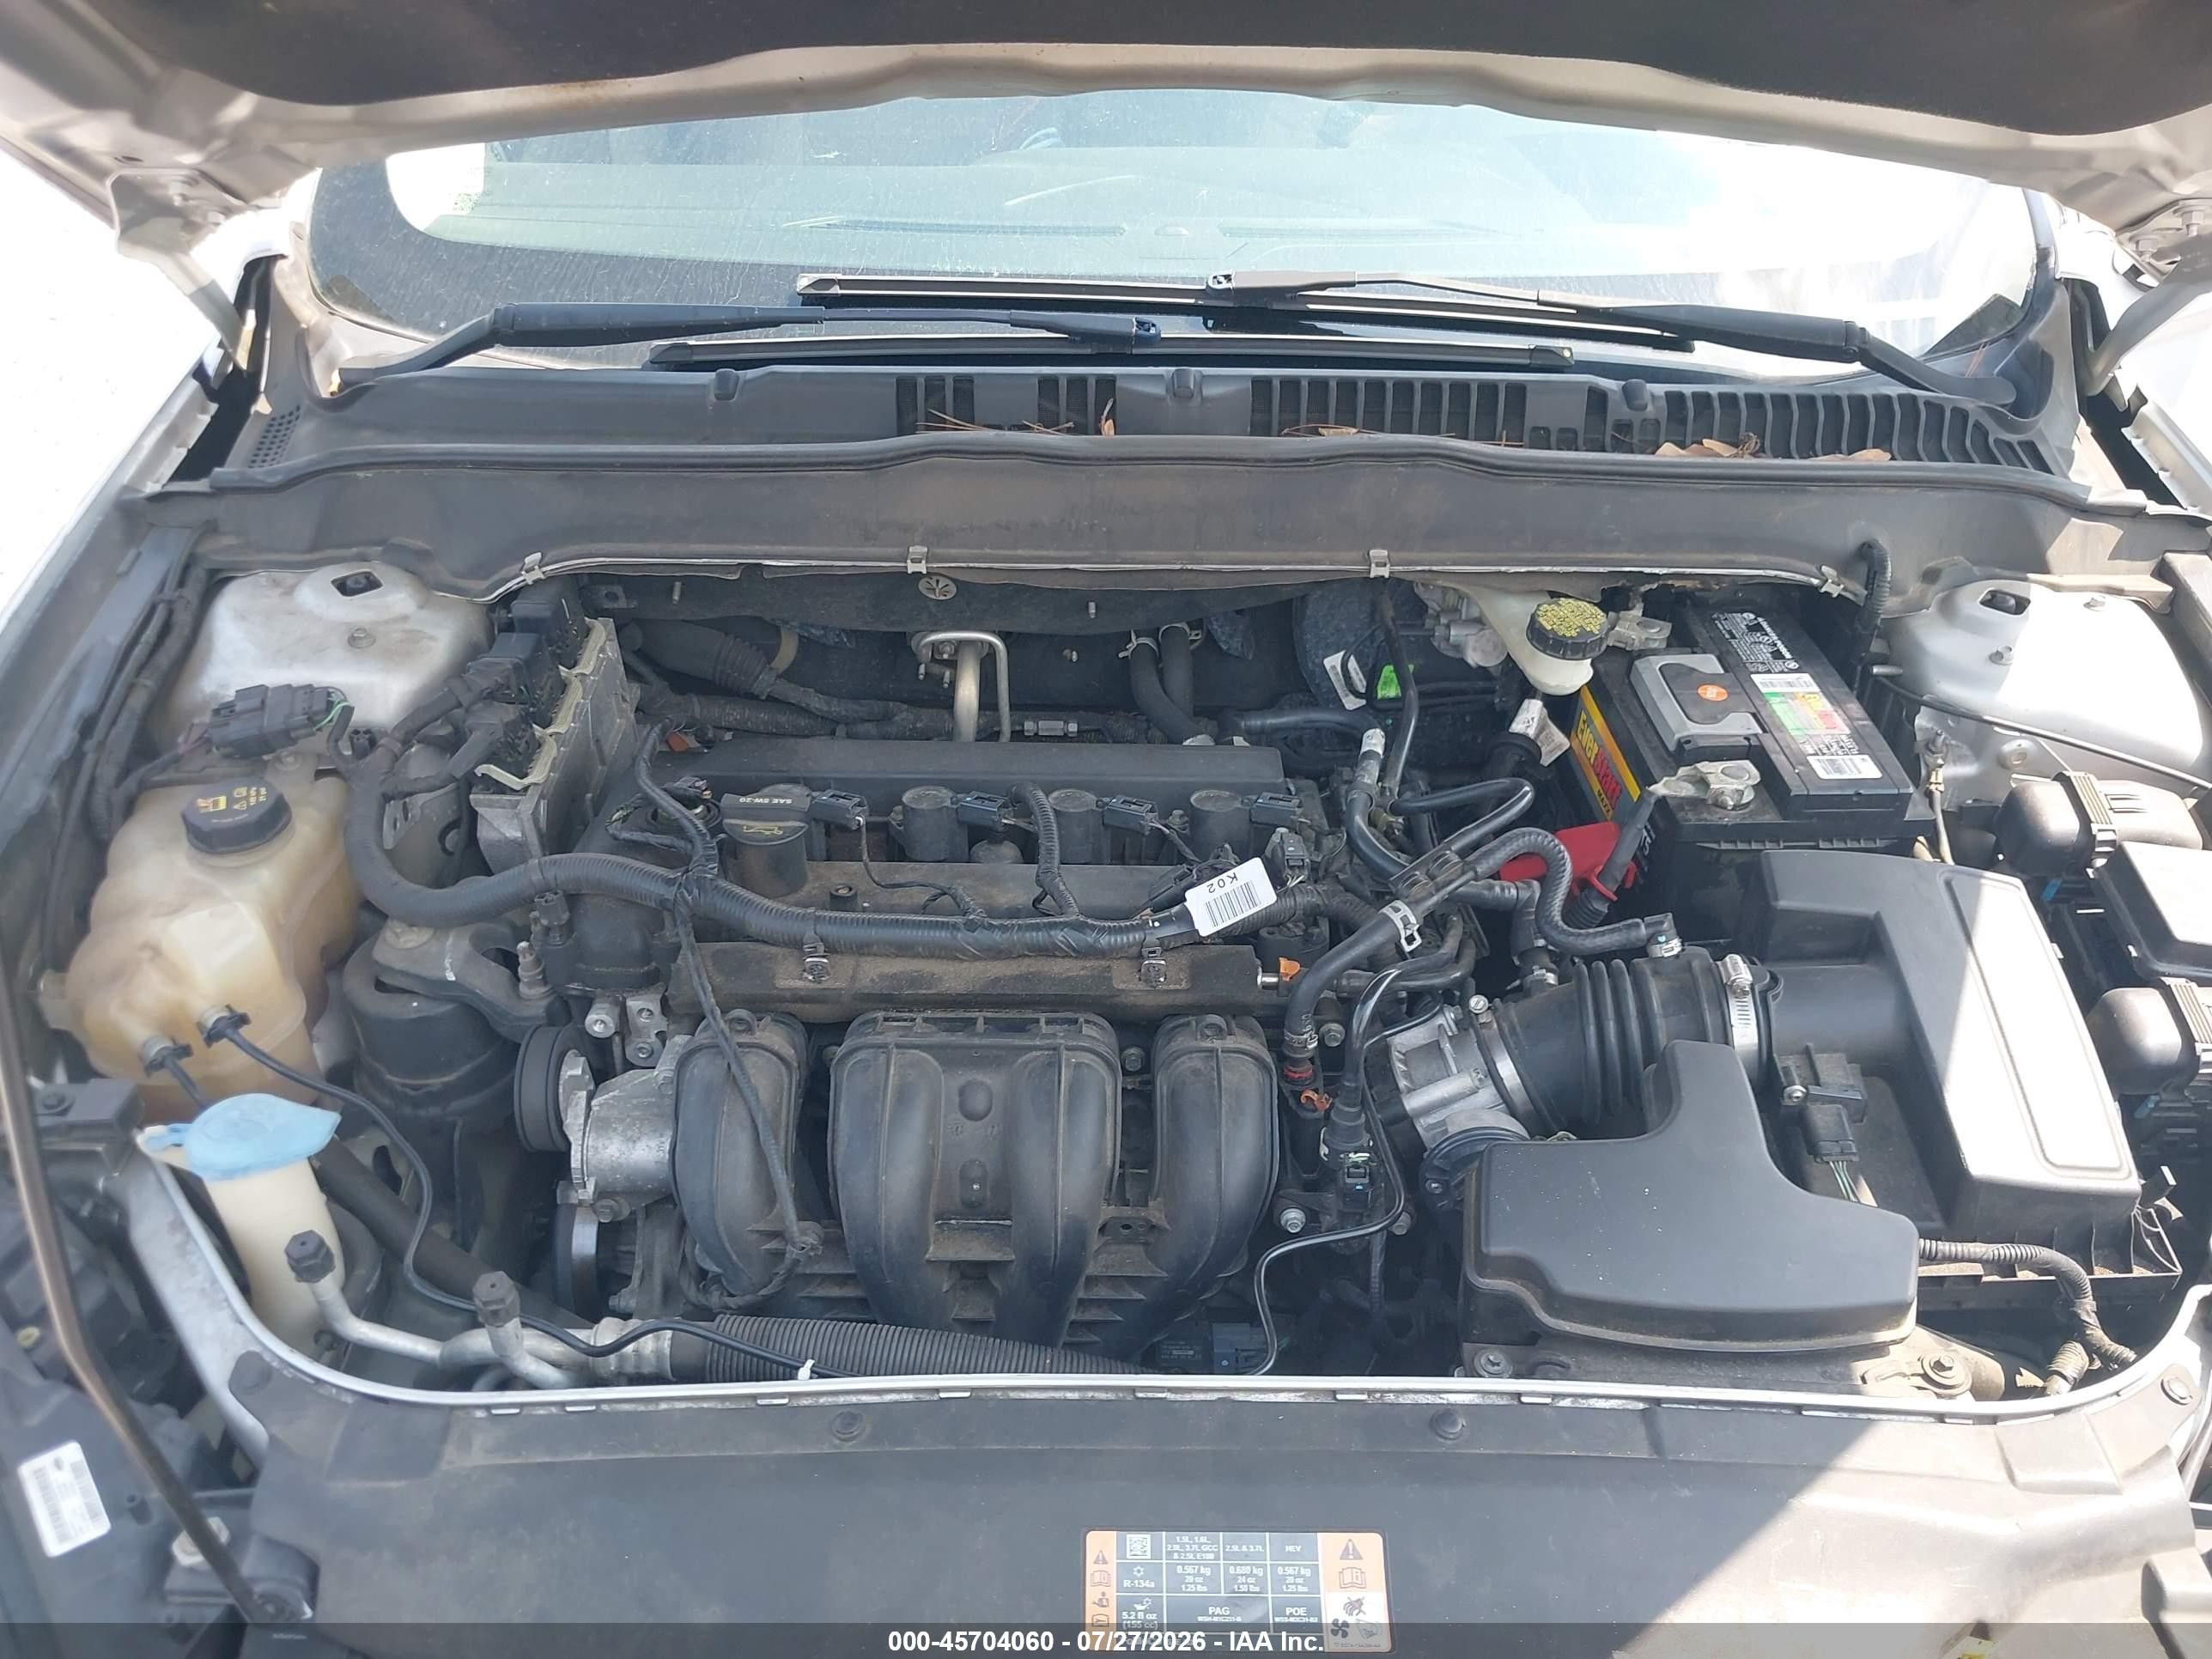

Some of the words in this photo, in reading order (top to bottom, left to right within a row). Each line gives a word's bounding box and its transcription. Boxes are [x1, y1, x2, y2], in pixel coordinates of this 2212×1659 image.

[1176, 1565, 1199, 1574] 0.567
[1200, 1565, 1211, 1577] kg
[1252, 1565, 1264, 1577] kg
[1277, 1566, 1298, 1575] 0.567
[1300, 1566, 1311, 1577] kg
[1123, 1579, 1155, 1588] R-134a
[1121, 1611, 1136, 1620] 5.2
[1137, 1611, 1145, 1620] fl
[1208, 1606, 1231, 1615] PAG
[1285, 1607, 1308, 1616] POE
[1122, 1620, 1142, 1630] (155
[1144, 1620, 1158, 1631] cc)
